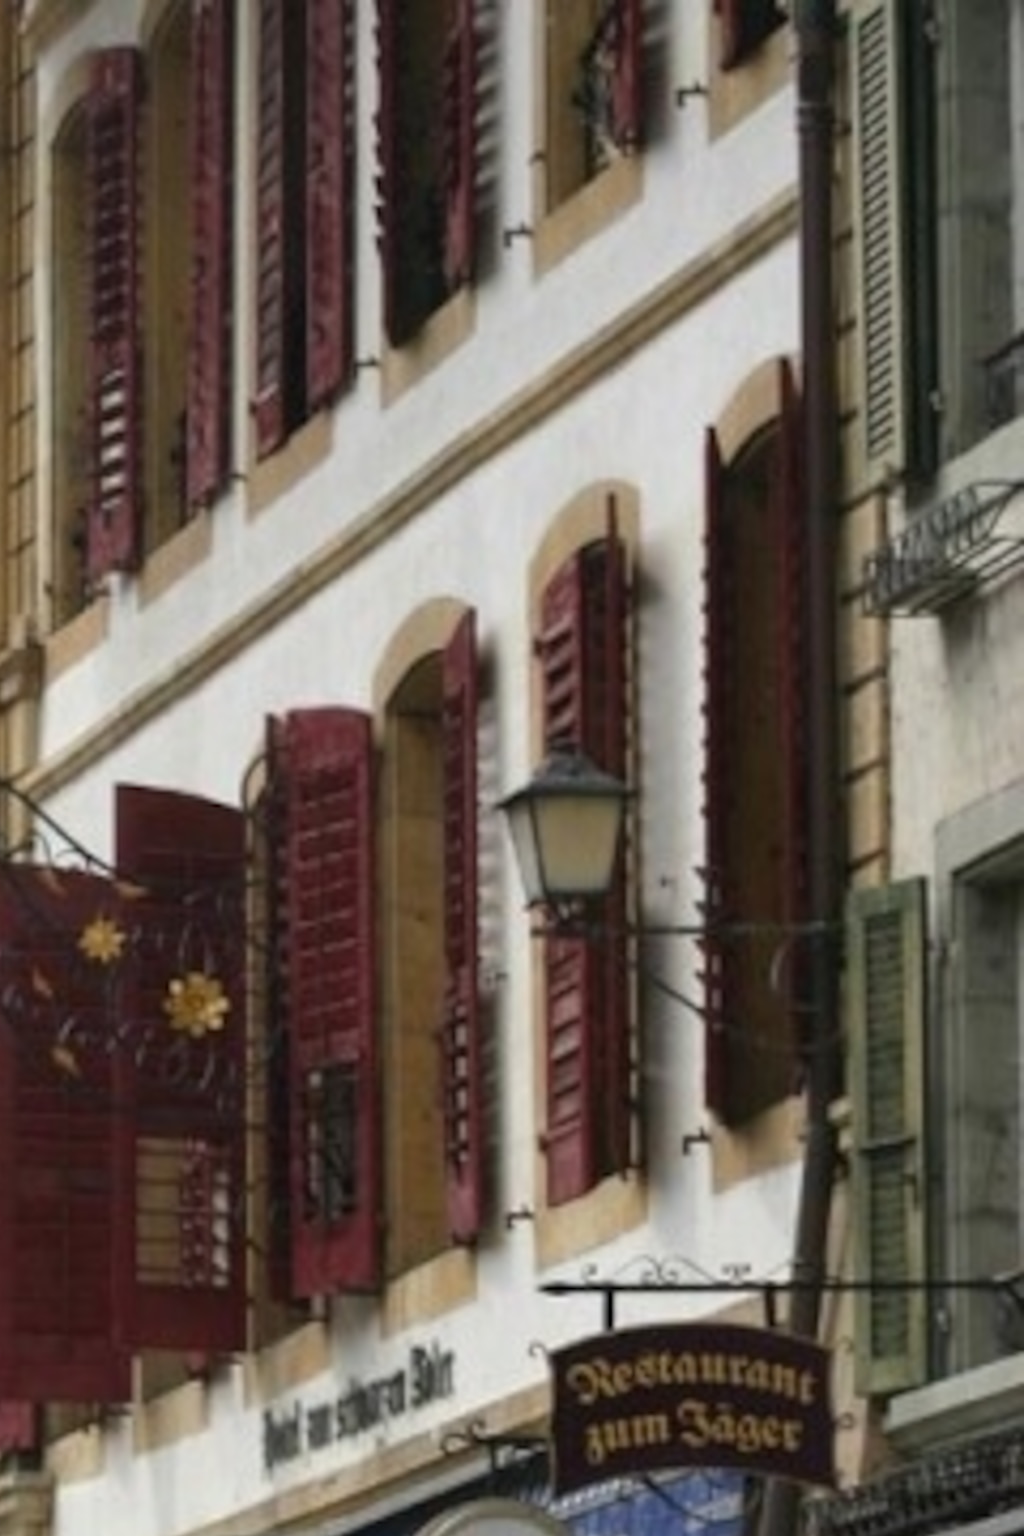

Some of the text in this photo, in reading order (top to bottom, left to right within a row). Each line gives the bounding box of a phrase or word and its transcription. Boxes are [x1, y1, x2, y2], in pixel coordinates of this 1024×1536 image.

[567, 1350, 816, 1403] Restaurant
[585, 1400, 804, 1465] zum Jäger
